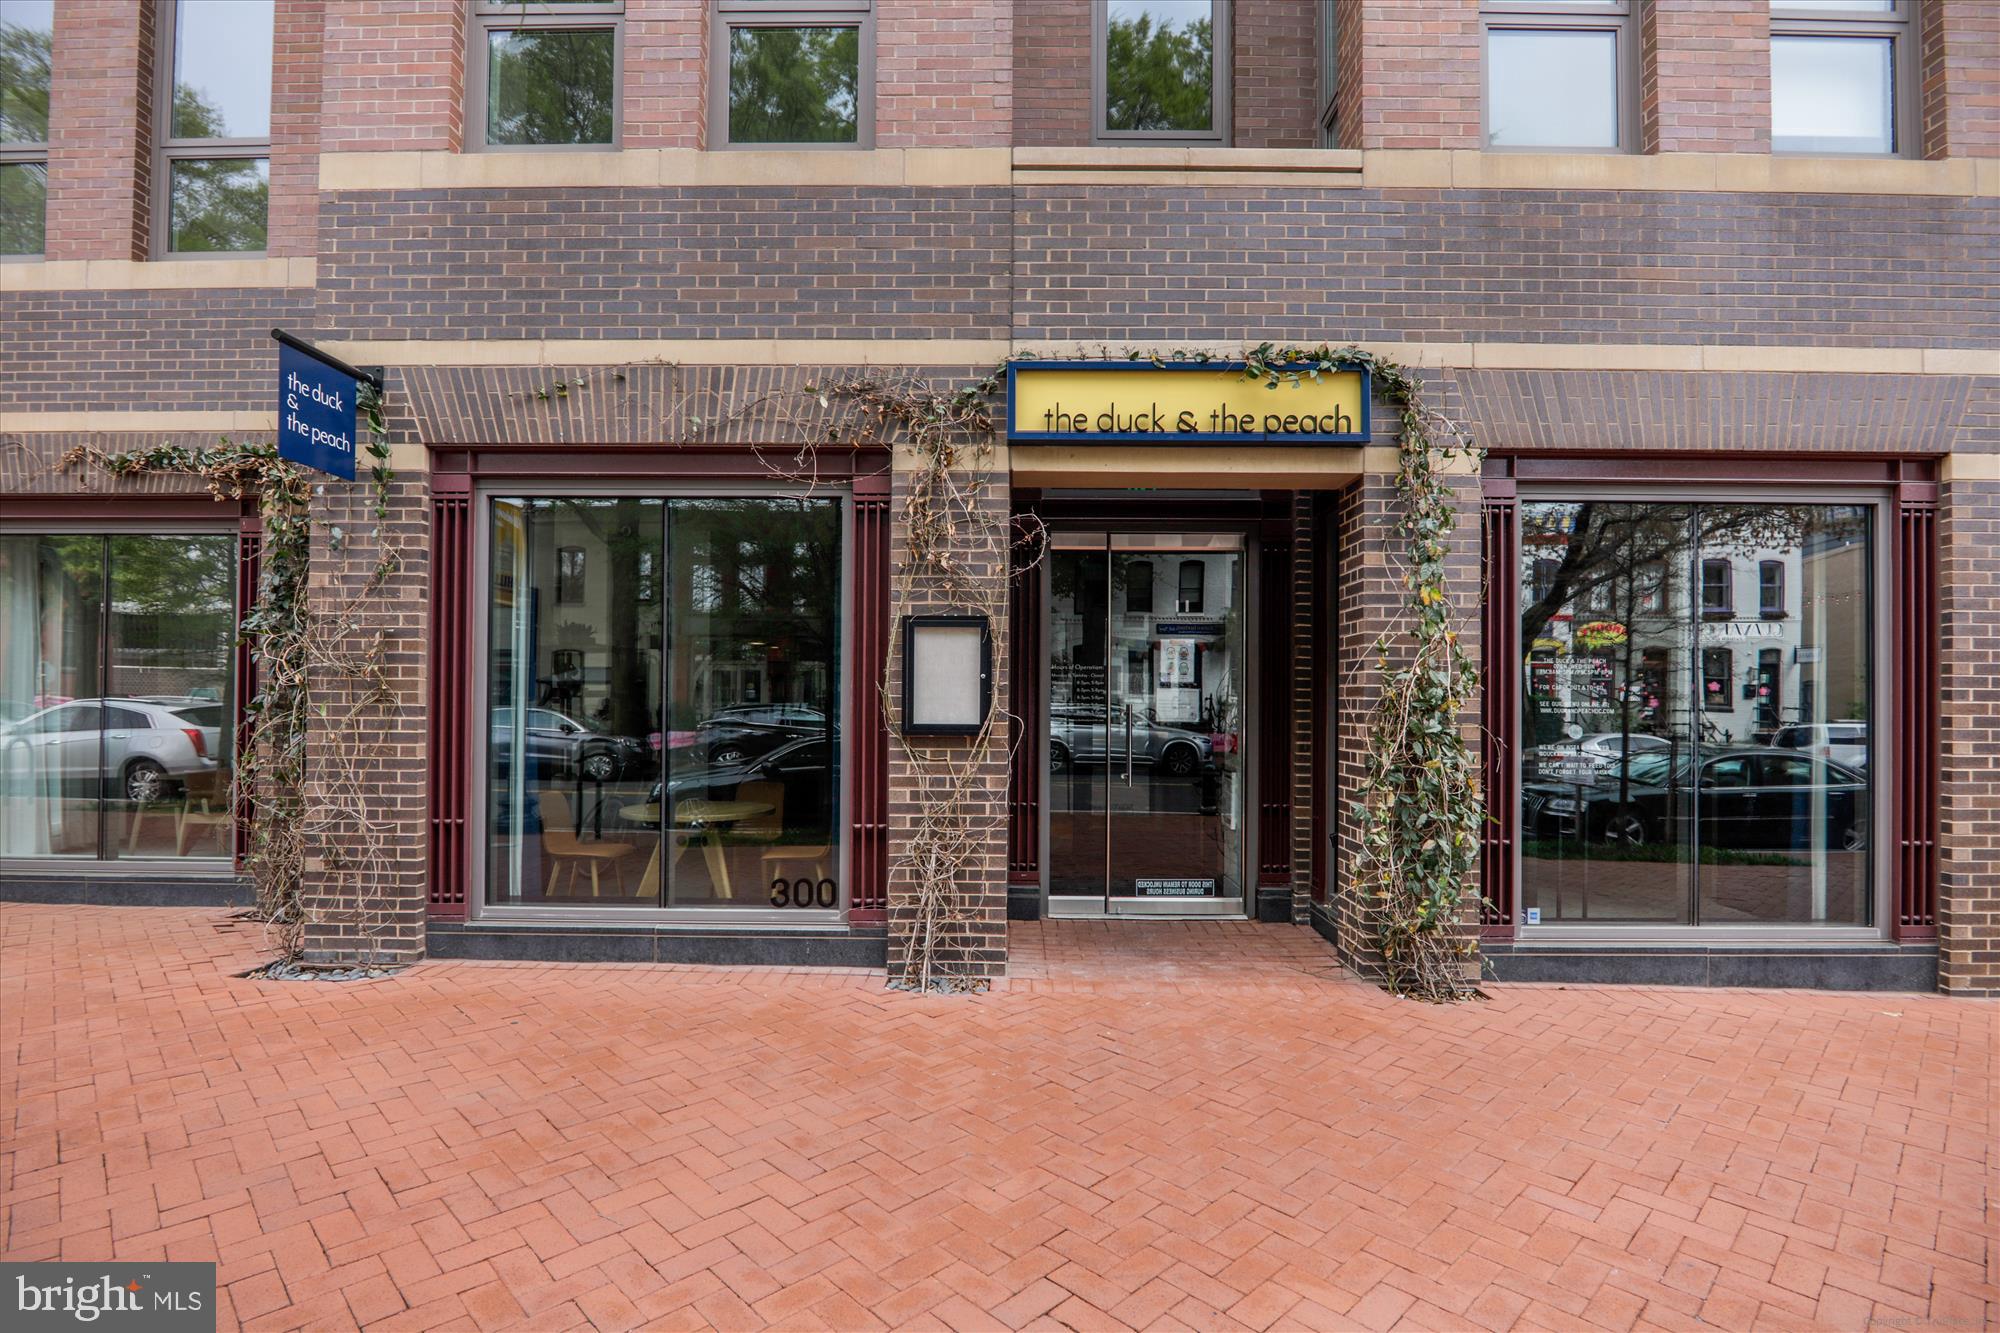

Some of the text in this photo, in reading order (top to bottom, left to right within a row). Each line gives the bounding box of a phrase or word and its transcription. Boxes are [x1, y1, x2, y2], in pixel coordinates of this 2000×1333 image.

[286, 393, 299, 411] &
[287, 371, 343, 412] the duck
[286, 412, 350, 453] the peach
[1044, 402, 1352, 440] the duck & the peach
[770, 878, 837, 908] 300
